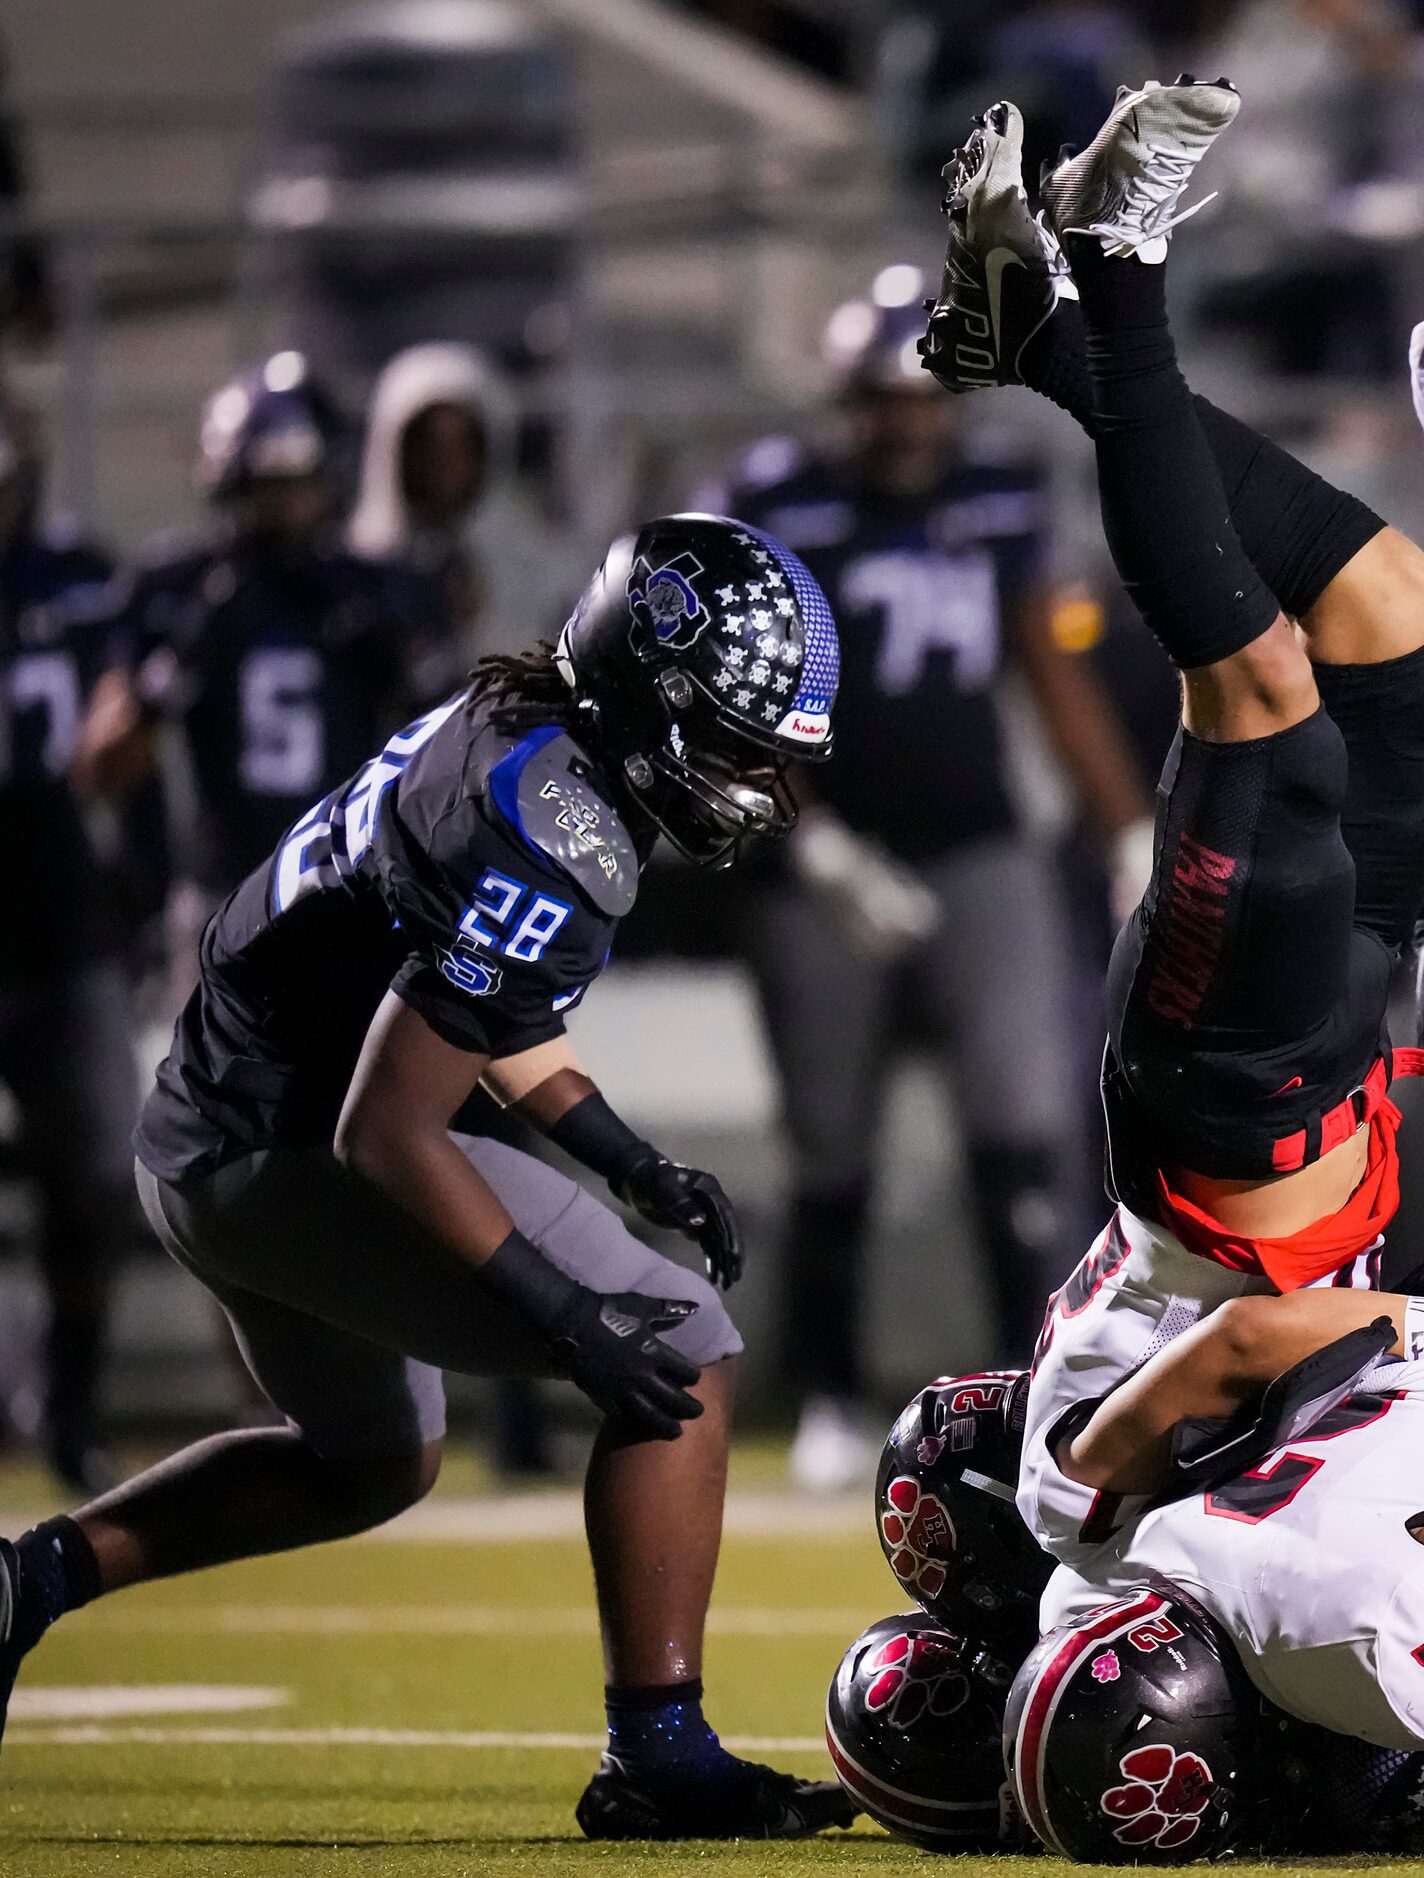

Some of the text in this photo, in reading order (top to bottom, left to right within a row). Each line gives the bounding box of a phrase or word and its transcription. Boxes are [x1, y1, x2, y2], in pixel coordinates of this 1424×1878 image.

[238, 646, 324, 795] 5
[456, 866, 574, 962] 28
[952, 1387, 1004, 1414] 2
[1127, 1614, 1185, 1653] 2
